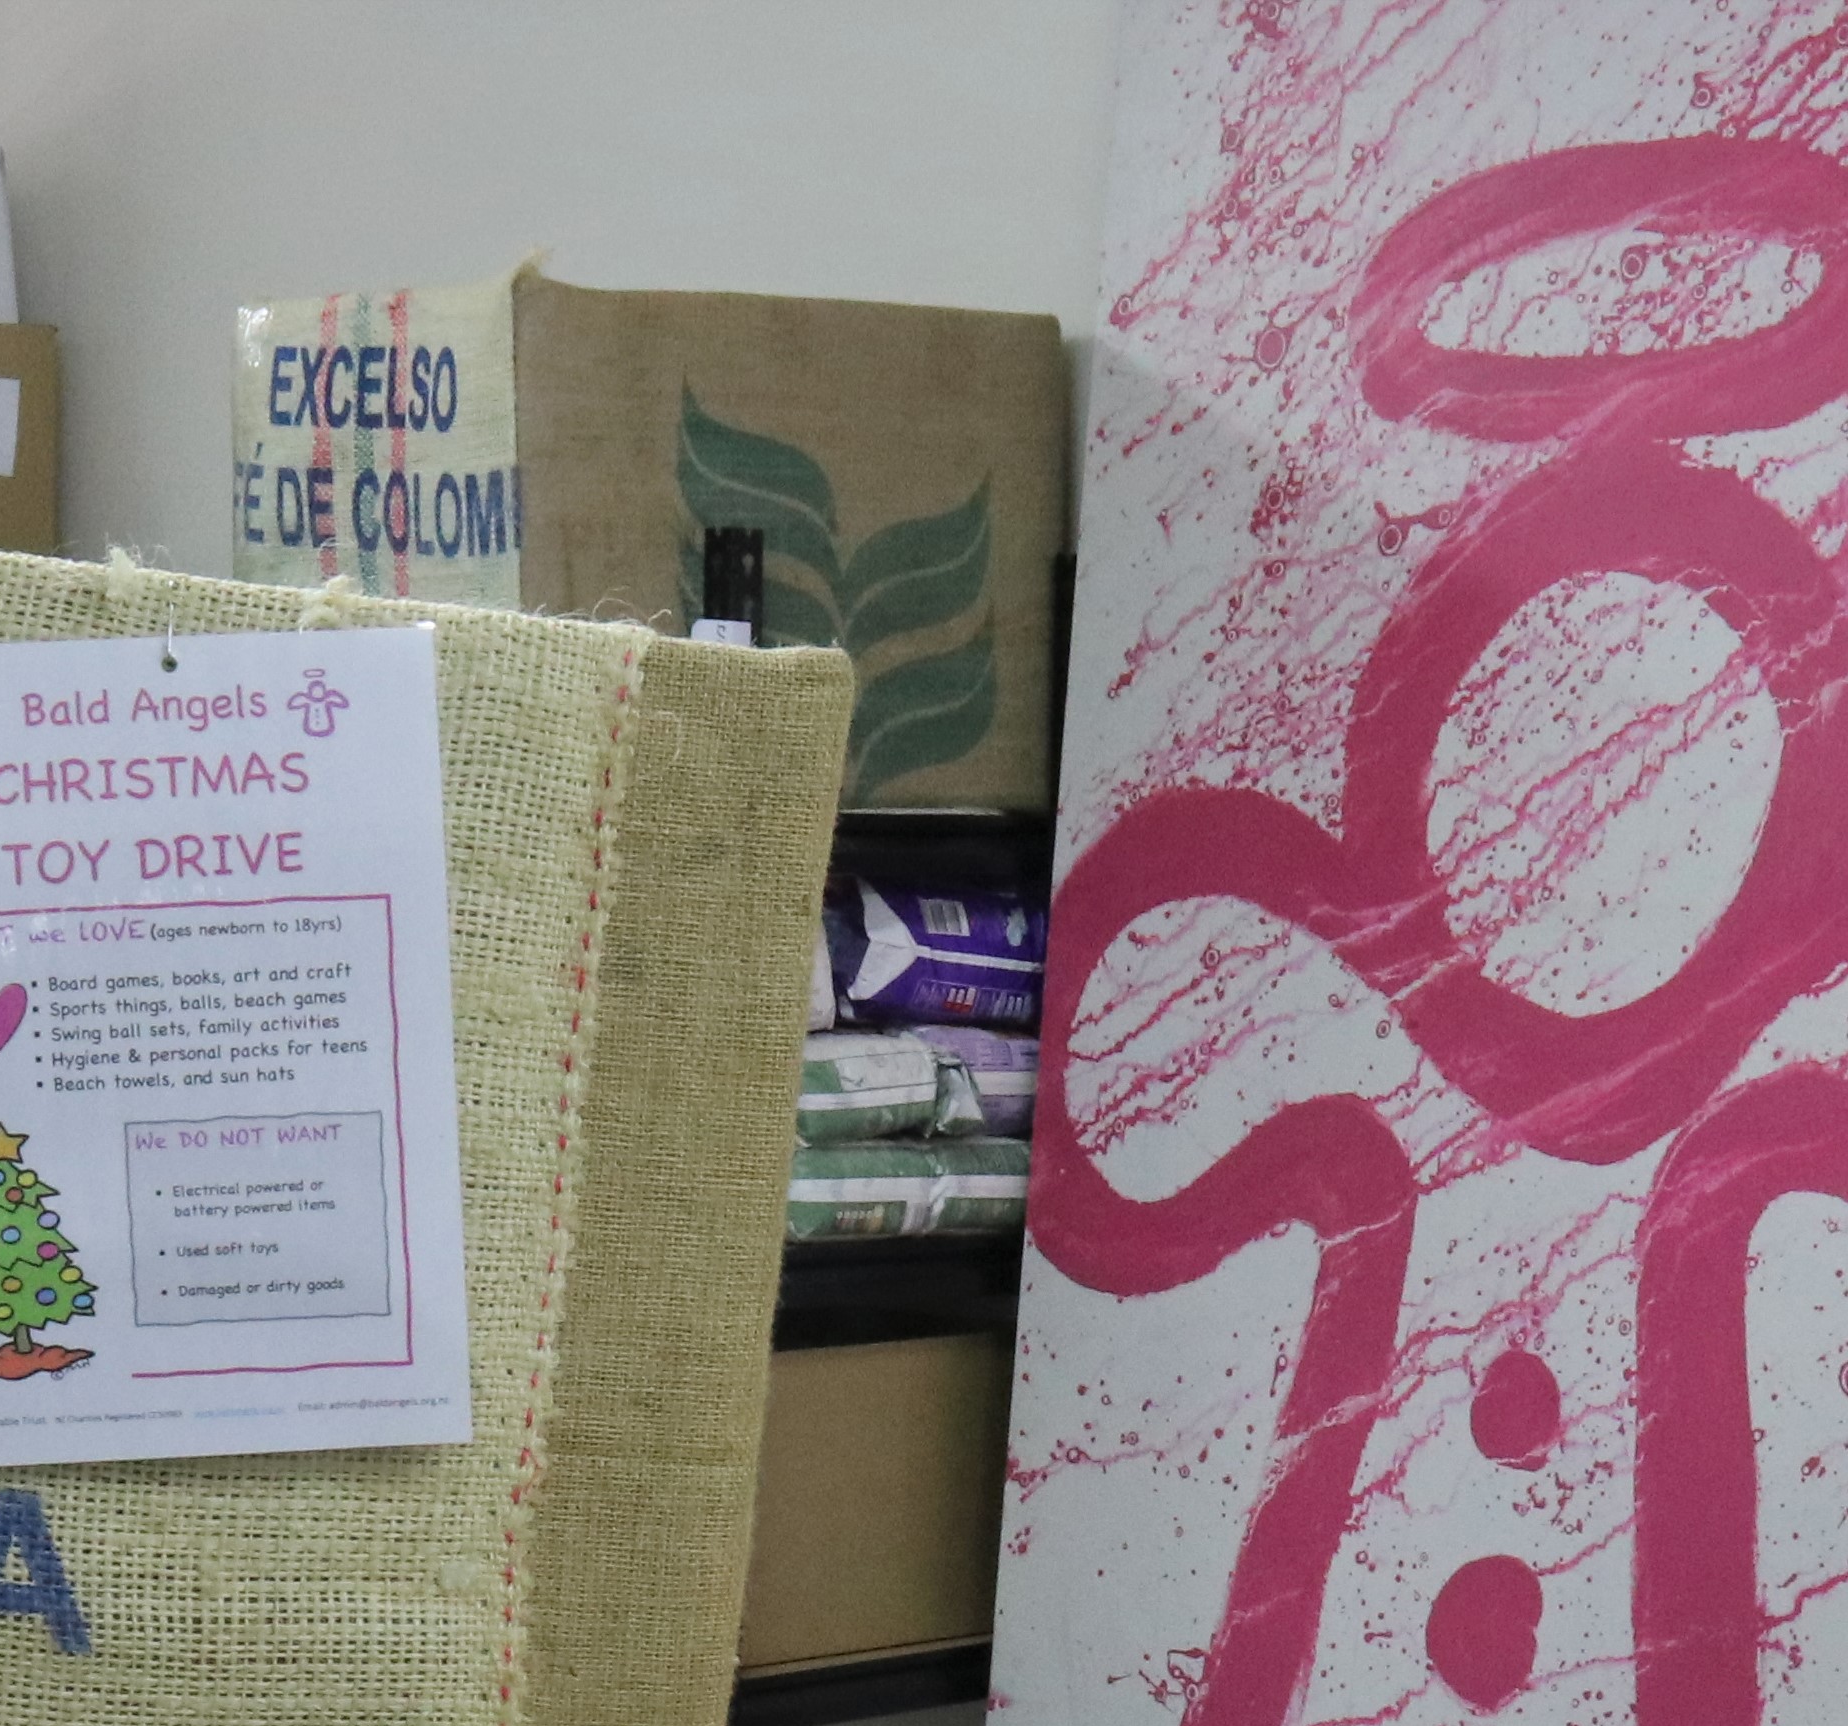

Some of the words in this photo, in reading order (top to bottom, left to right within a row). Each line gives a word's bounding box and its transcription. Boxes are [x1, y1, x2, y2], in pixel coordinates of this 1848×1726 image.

[269, 344, 457, 433] EXCELSO
[276, 466, 337, 549] DE
[21, 689, 109, 728] Bald
[131, 684, 268, 732] Angels
[1, 839, 111, 887] TOY
[134, 832, 304, 881] DRIVE
[29, 929, 67, 944] we
[79, 916, 146, 943] LOVE
[149, 922, 193, 943] (ages
[198, 920, 266, 937] newborn
[273, 919, 290, 934] to
[294, 915, 344, 936] 18yrs)
[48, 974, 98, 993] Board
[106, 974, 165, 994] games,
[172, 968, 226, 987] books,
[233, 966, 261, 984] art
[268, 965, 299, 983] and
[305, 961, 352, 981] craft
[49, 1000, 107, 1021] Sports
[115, 997, 173, 1017] things,
[180, 994, 227, 1012] balls,
[234, 991, 287, 1009] beach
[293, 991, 348, 1011] games
[50, 1025, 102, 1045] Swing
[109, 1022, 142, 1040] ball
[149, 1021, 191, 1038] sets,
[198, 1017, 253, 1037] family
[259, 1014, 341, 1034] activities
[51, 1050, 121, 1071] Hygiene
[128, 1048, 142, 1064] &
[149, 1044, 222, 1067] personal
[229, 1042, 280, 1064] packs
[287, 1039, 313, 1057] for
[321, 1038, 369, 1055] teens
[53, 1076, 106, 1093] Beach
[113, 1071, 176, 1090] towels,
[182, 1069, 214, 1087] and
[220, 1071, 250, 1085] sun
[257, 1065, 296, 1083] hats
[135, 1131, 168, 1151] We
[179, 1130, 209, 1149] DO
[219, 1127, 265, 1147] NOT
[277, 1124, 343, 1145] WANT
[171, 1181, 240, 1198] Electrical
[245, 1178, 305, 1198] powered
[309, 1180, 325, 1192] or
[173, 1203, 230, 1219] battery
[233, 1199, 294, 1218] powered
[298, 1198, 337, 1212] items
[176, 1244, 210, 1259] Used
[214, 1242, 244, 1257] soft
[249, 1240, 280, 1257] toys
[177, 1282, 242, 1300] Damaged
[245, 1282, 262, 1295] or
[265, 1279, 302, 1296] dirty
[305, 1277, 346, 1296] goods
